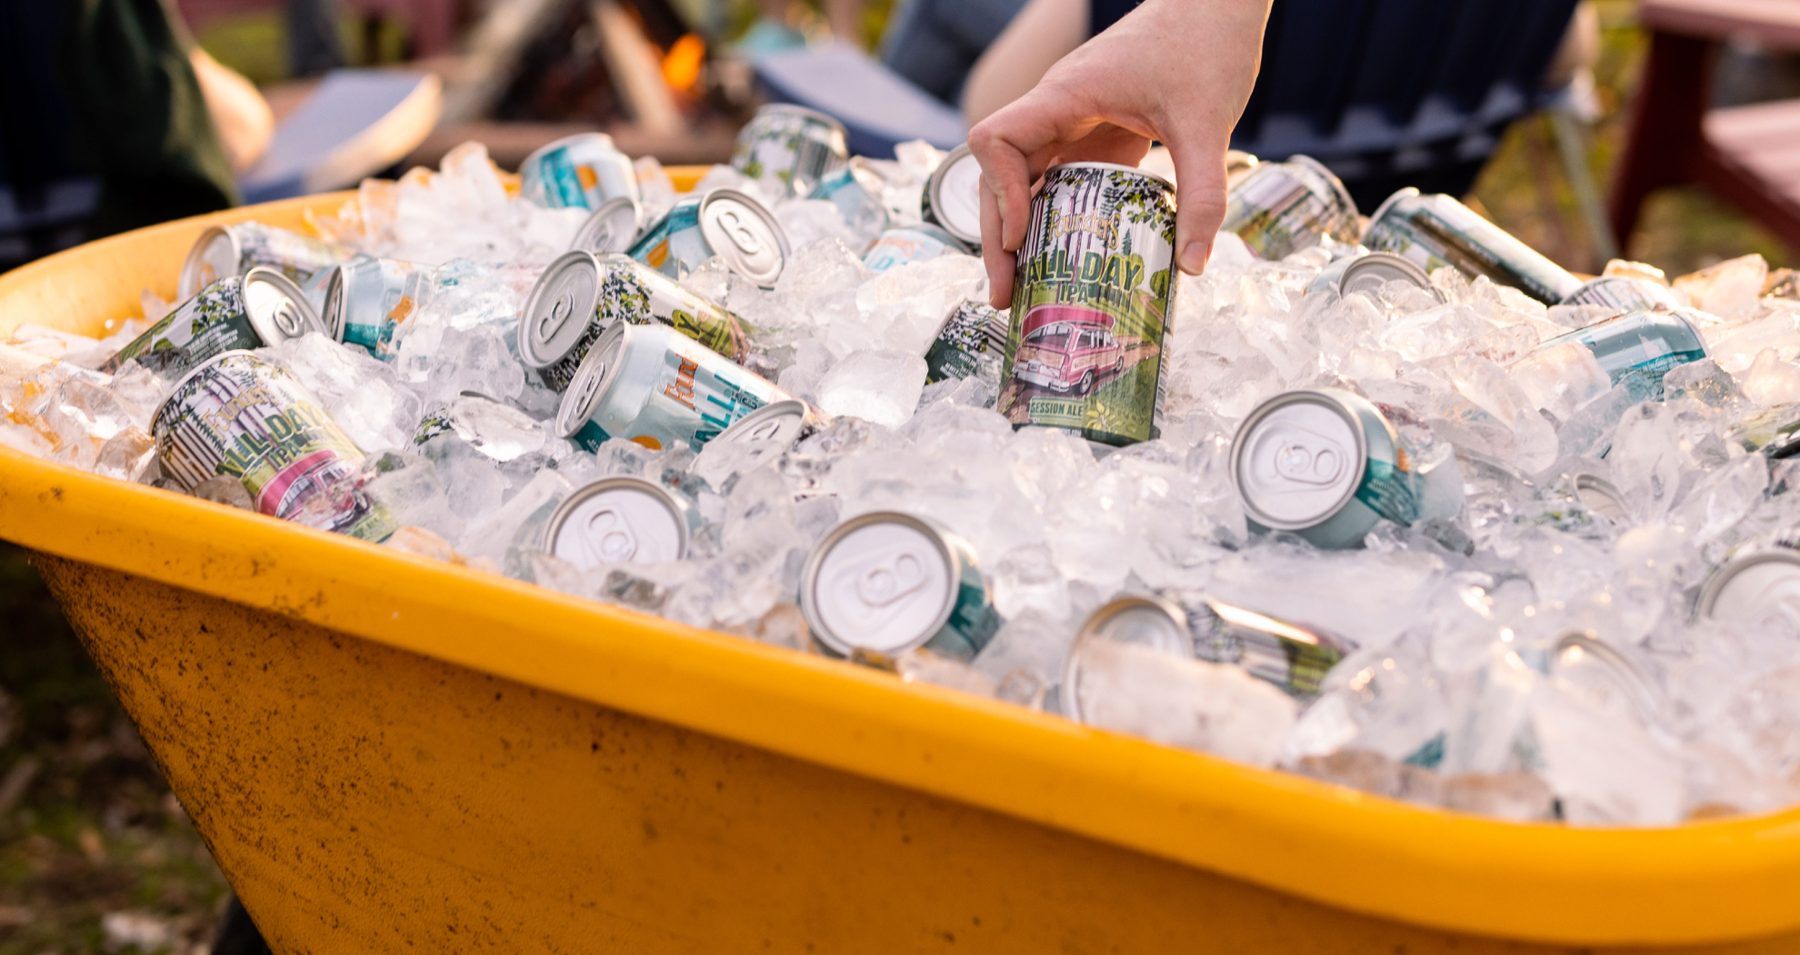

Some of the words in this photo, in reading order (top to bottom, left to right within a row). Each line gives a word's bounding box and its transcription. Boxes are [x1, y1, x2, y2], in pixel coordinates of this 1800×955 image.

[1026, 248, 1073, 288] ALL
[1080, 251, 1142, 292] DAY
[1059, 283, 1089, 304] IPA
[1030, 401, 1065, 415] SESSION
[1067, 403, 1083, 417] ALE
